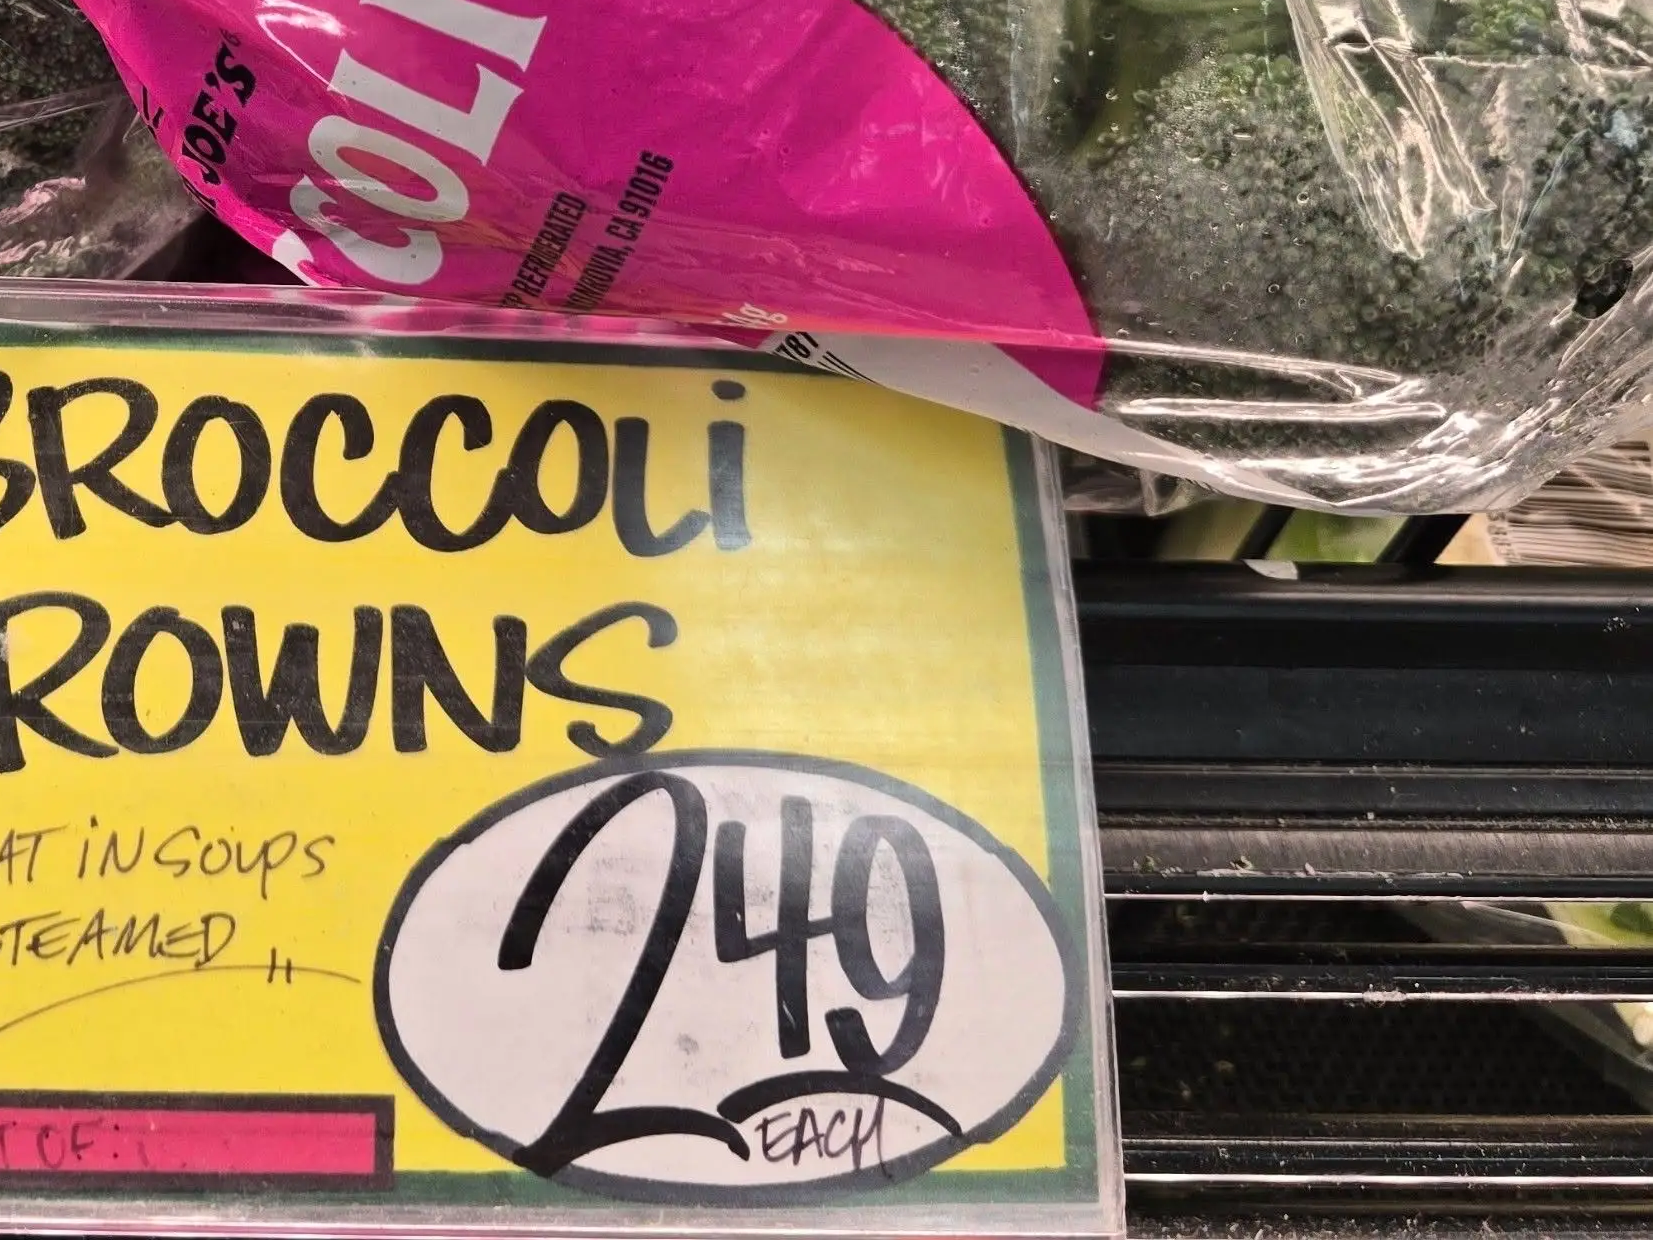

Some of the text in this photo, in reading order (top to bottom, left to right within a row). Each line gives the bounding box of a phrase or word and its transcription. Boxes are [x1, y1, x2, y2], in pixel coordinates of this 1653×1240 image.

[182, 42, 256, 185] JOE'S
[617, 149, 674, 219] 91016
[511, 192, 587, 298] REFRIGERATED
[605, 215, 645, 242] CA
[154, 826, 337, 900] SOUPS
[754, 1094, 894, 1179] EACH
